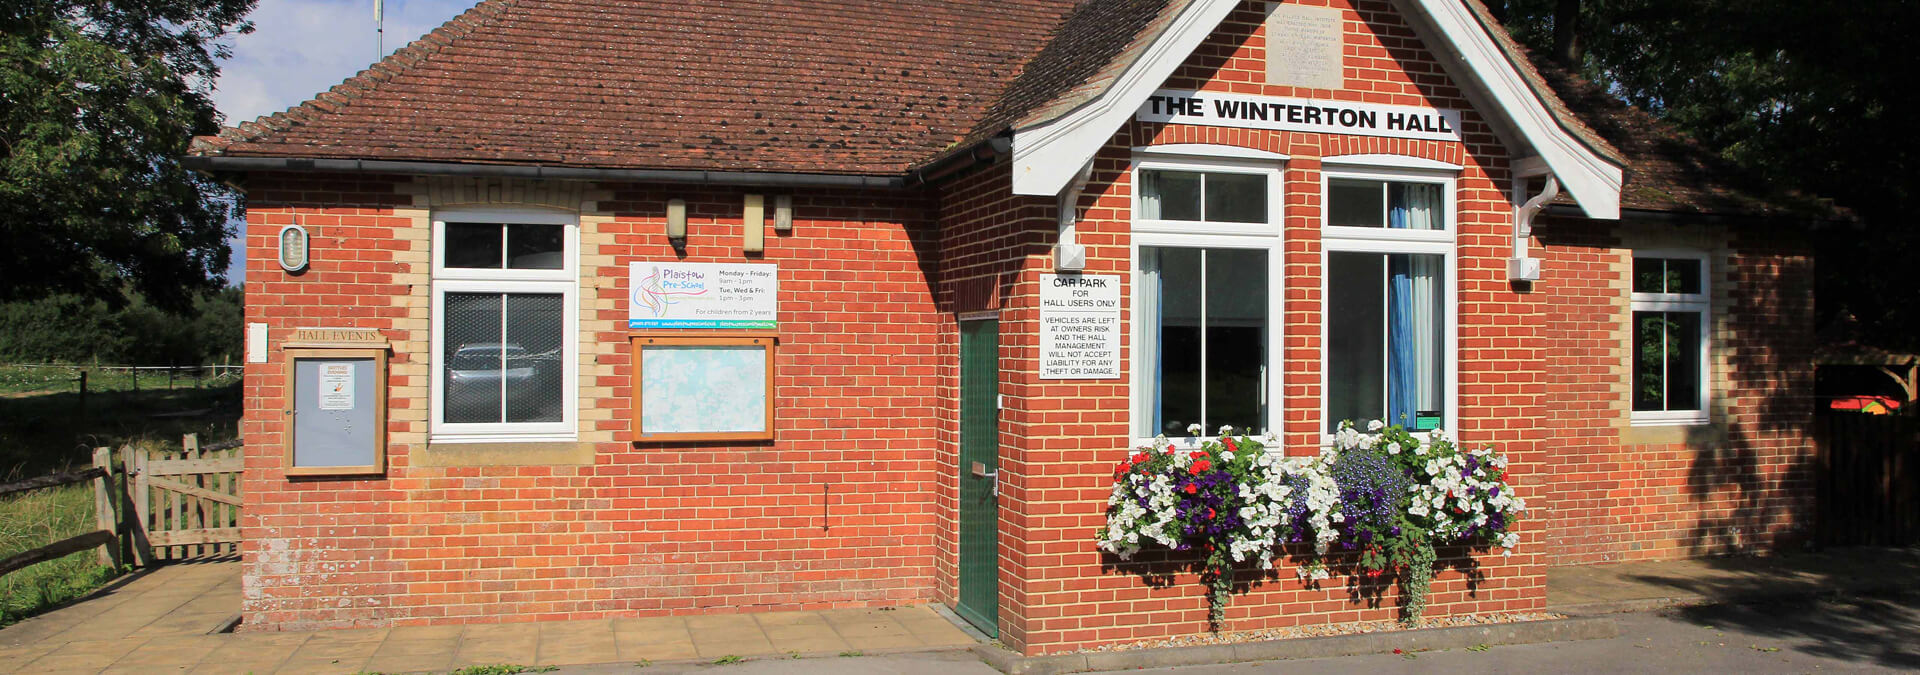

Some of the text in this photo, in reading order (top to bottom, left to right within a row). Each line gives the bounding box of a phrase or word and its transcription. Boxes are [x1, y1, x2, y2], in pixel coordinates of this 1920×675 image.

[1149, 95, 1452, 133] THE WINTERTON HALL
[663, 269, 705, 281] Plaistow
[719, 270, 745, 278] Monday
[750, 270, 772, 278] Friday:
[1053, 278, 1107, 288] CAR PARK
[1044, 299, 1065, 307] HALL
[1068, 299, 1094, 307] USERS
[298, 330, 376, 340] HALL EVENTS
